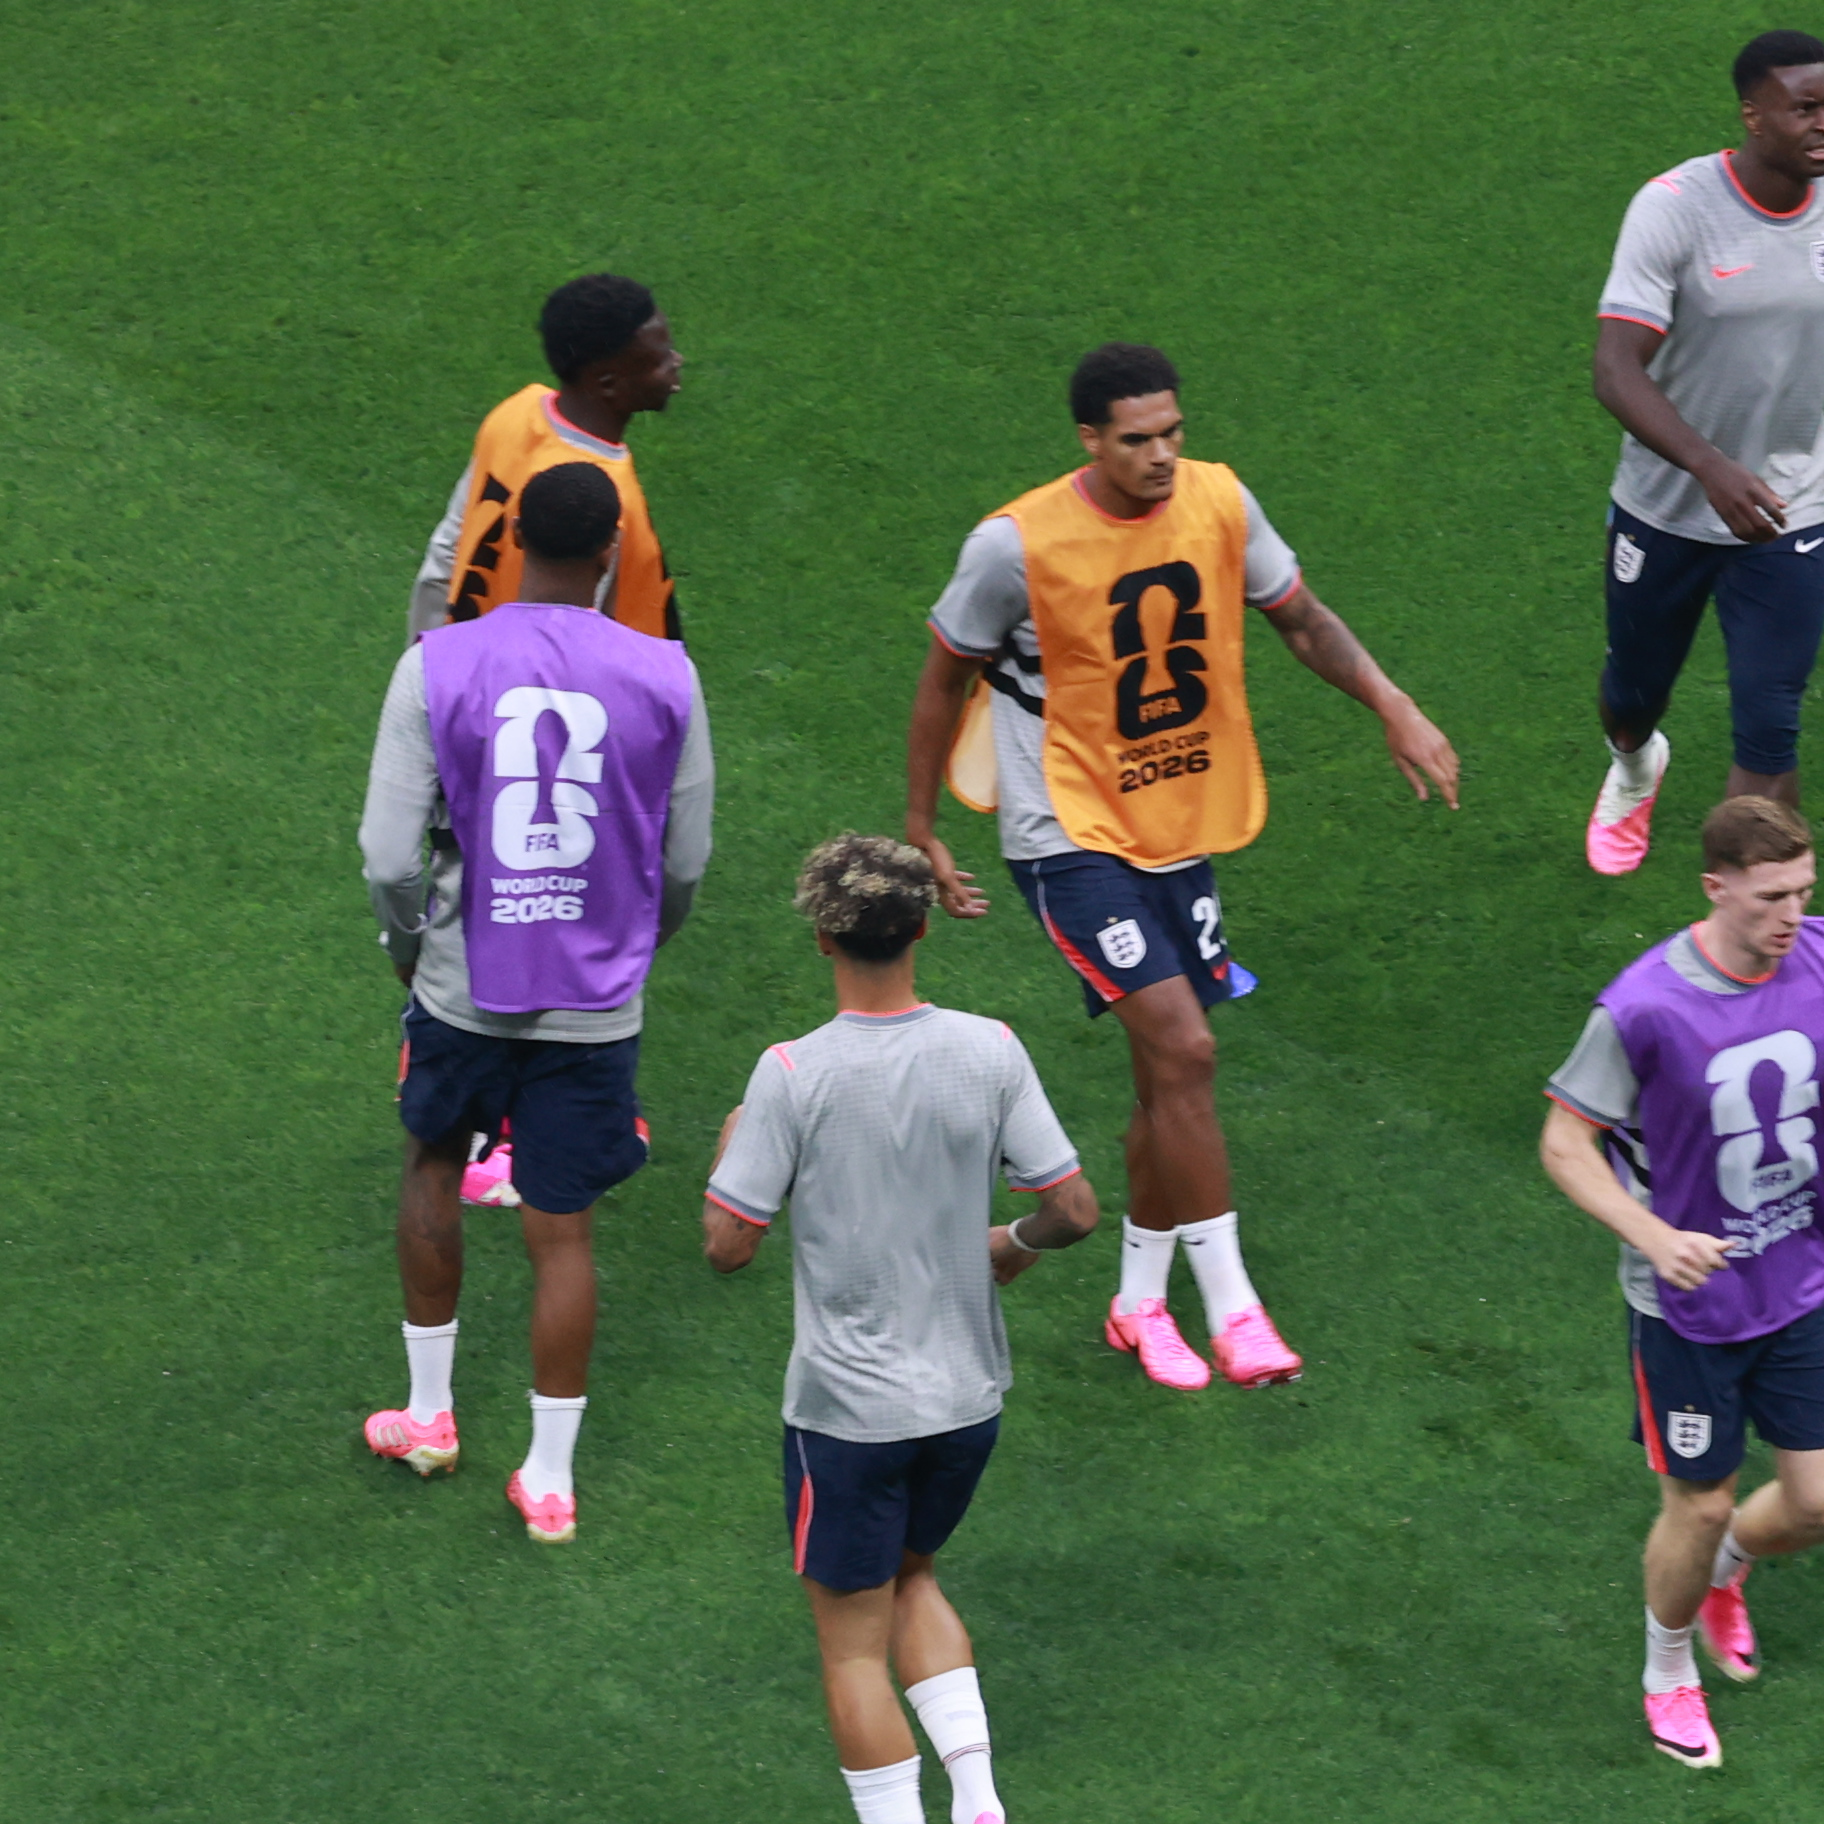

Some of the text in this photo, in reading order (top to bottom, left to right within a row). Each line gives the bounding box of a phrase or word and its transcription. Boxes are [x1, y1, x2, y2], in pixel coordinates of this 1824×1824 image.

[1118, 749, 1211, 793] 2026
[525, 833, 560, 852] FIFA
[490, 875, 588, 894] WORLD CUP
[490, 895, 584, 924] 2026
[1191, 891, 1228, 960] 2
